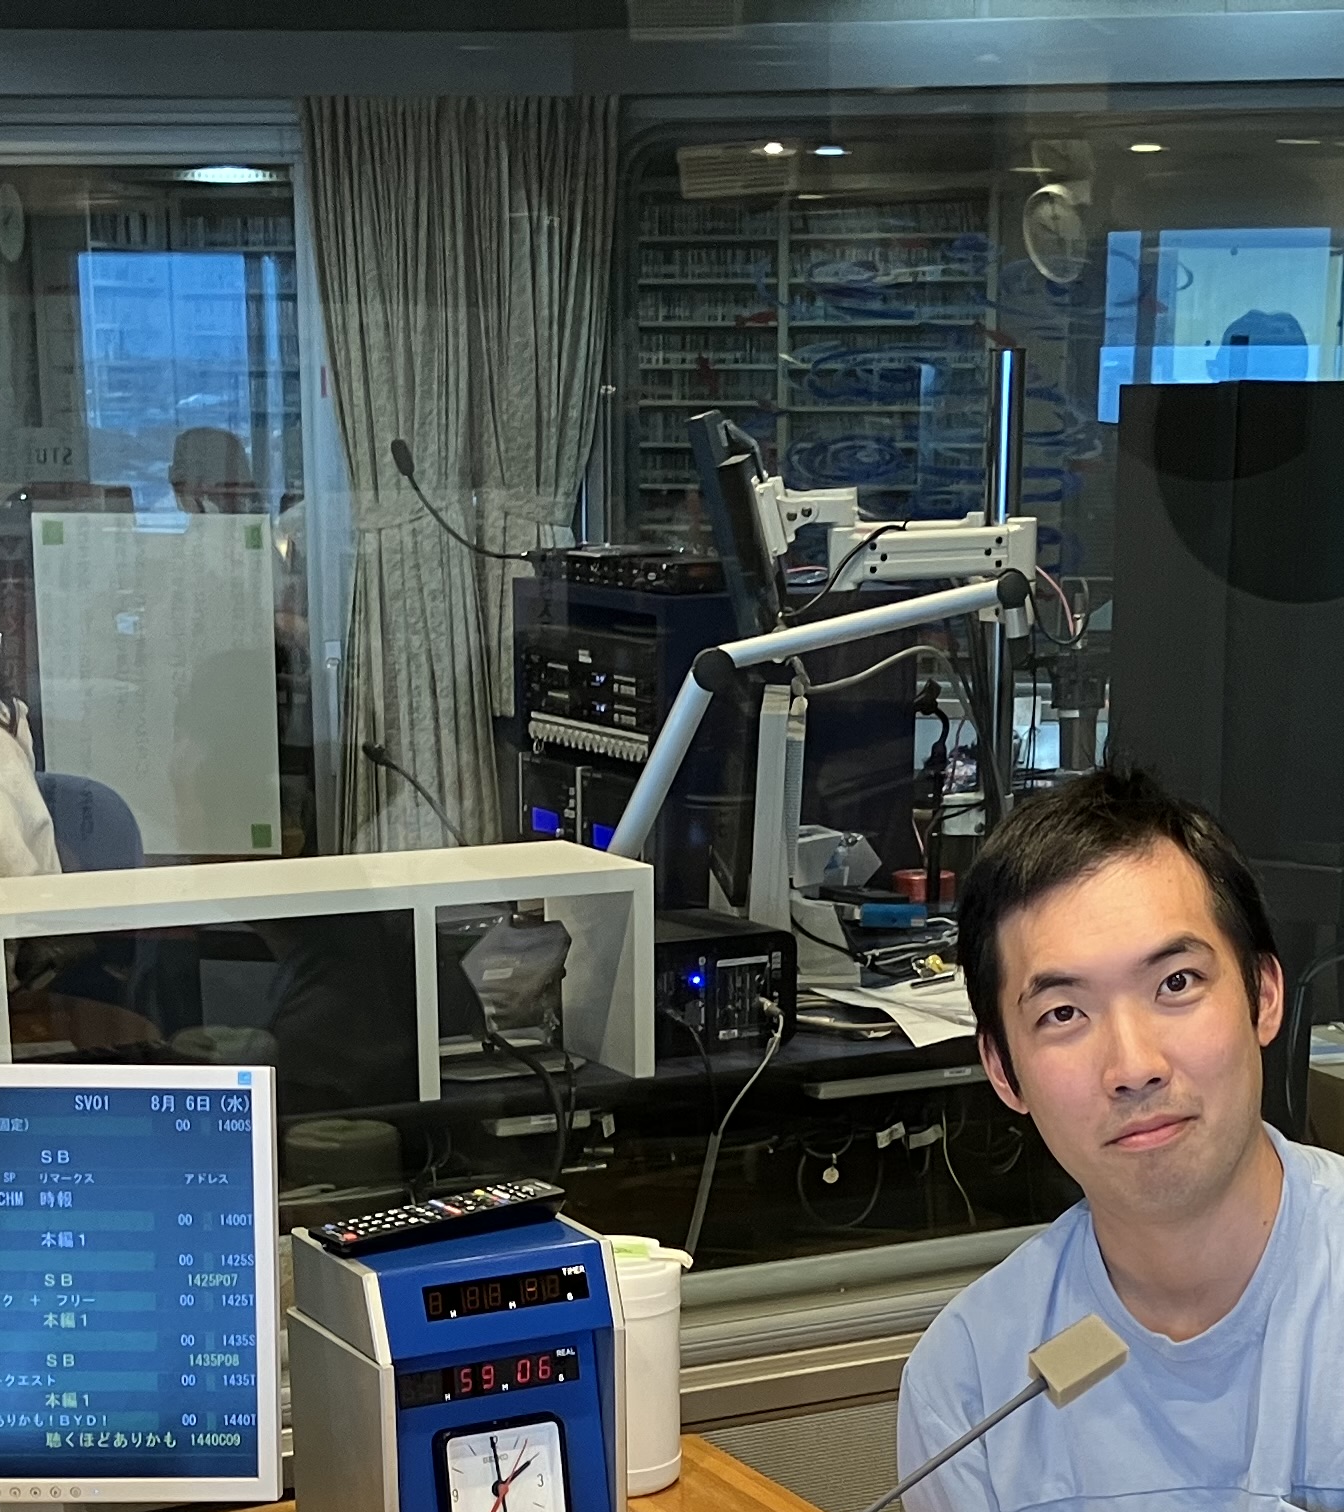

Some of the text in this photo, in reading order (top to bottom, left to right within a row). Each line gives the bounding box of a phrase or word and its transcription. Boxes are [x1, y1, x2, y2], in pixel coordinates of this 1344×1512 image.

[75, 1095, 110, 1111] SV01
[151, 1095, 175, 1112] 8月
[186, 1096, 210, 1111] 6日
[176, 1119, 190, 1131] 00
[39, 1173, 95, 1184] リマークス
[185, 1173, 229, 1184] アドレス
[40, 1191, 73, 1208] 時報
[177, 1214, 192, 1226] 00
[178, 1254, 193, 1266] 00
[562, 1265, 586, 1276] TIMER
[187, 1274, 238, 1287] 1425P07
[179, 1295, 194, 1306] 00
[180, 1334, 195, 1346] 00
[556, 1348, 576, 1357] REAL
[189, 1354, 239, 1367] 1435P08
[459, 1355, 551, 1393] 59 06
[181, 1375, 196, 1387] 00
[182, 1414, 197, 1426] 00
[190, 1434, 241, 1447] 1440C09
[537, 1473, 545, 1488] 3
